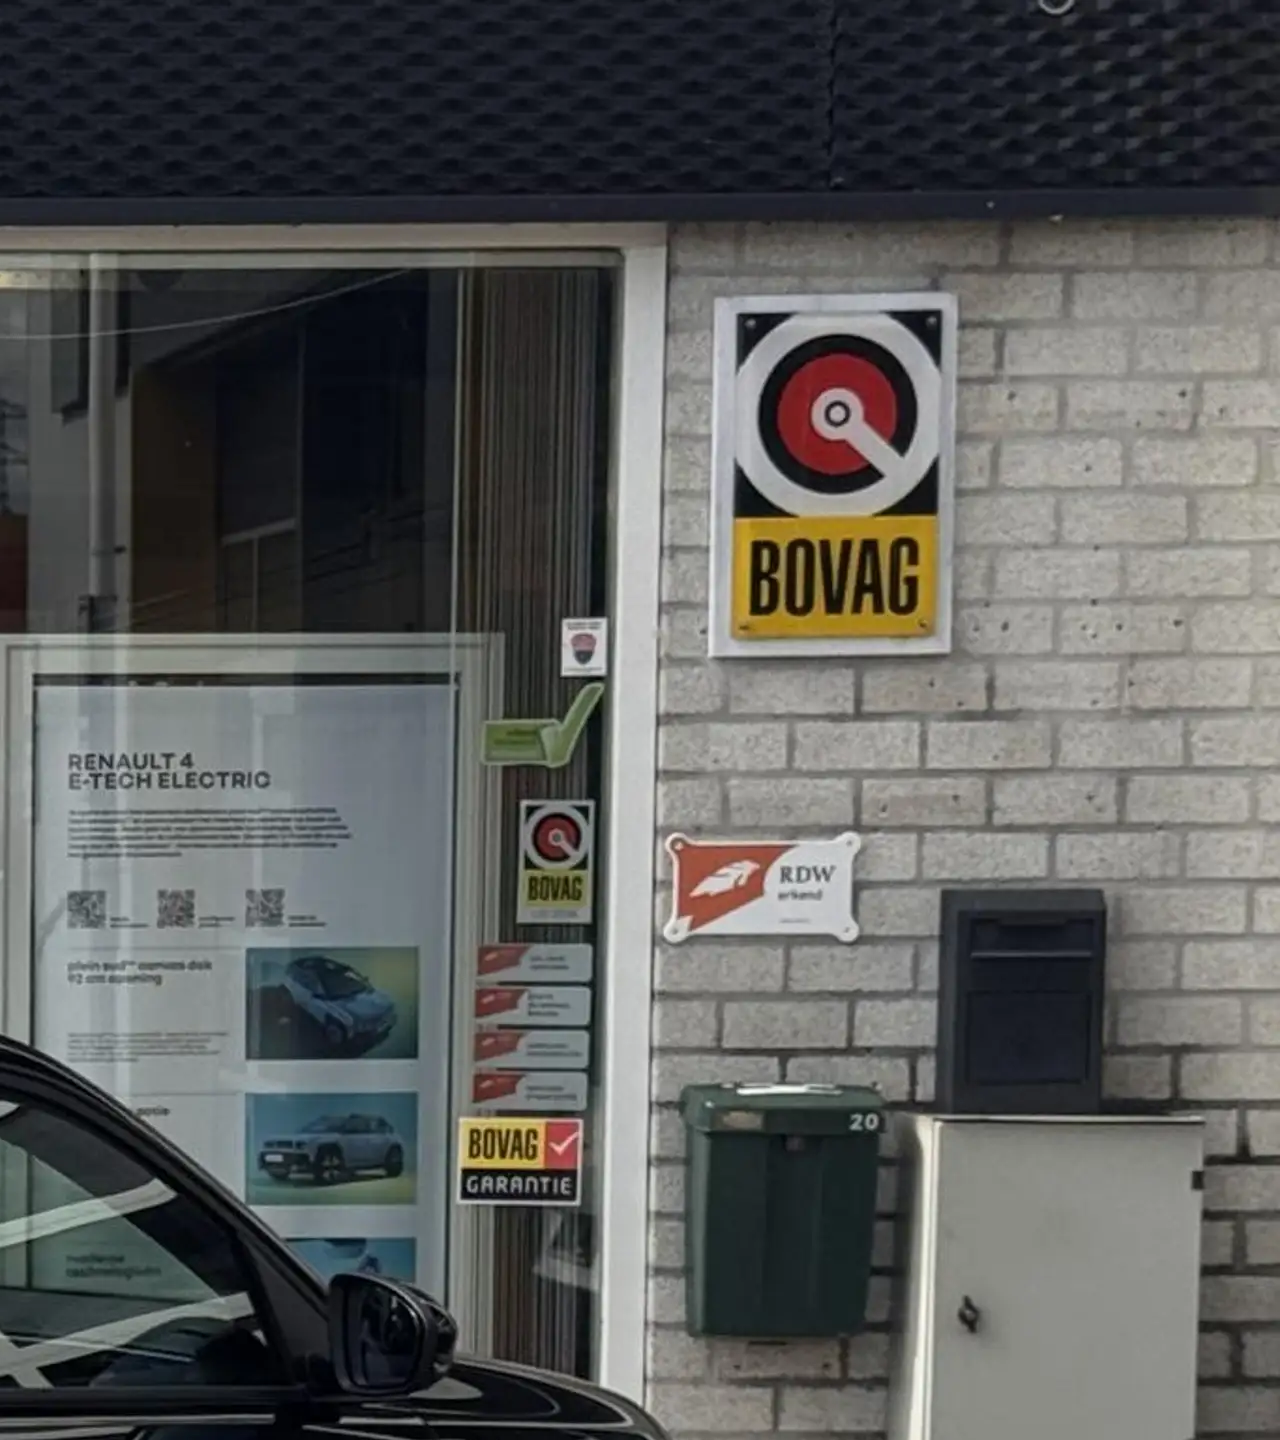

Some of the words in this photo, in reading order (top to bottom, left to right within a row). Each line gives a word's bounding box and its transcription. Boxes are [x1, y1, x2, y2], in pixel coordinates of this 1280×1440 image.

[750, 537, 919, 616] BOVAG
[68, 753, 176, 770] RENAULT
[179, 753, 194, 770] 4
[68, 771, 151, 790] E-TECH
[157, 771, 272, 790] ELECTRIC
[780, 864, 838, 885] RDW
[528, 875, 585, 901] BOVAG
[849, 1113, 879, 1131] 20
[468, 1129, 539, 1160] BOVAG
[466, 1175, 572, 1196] GARANTIE
